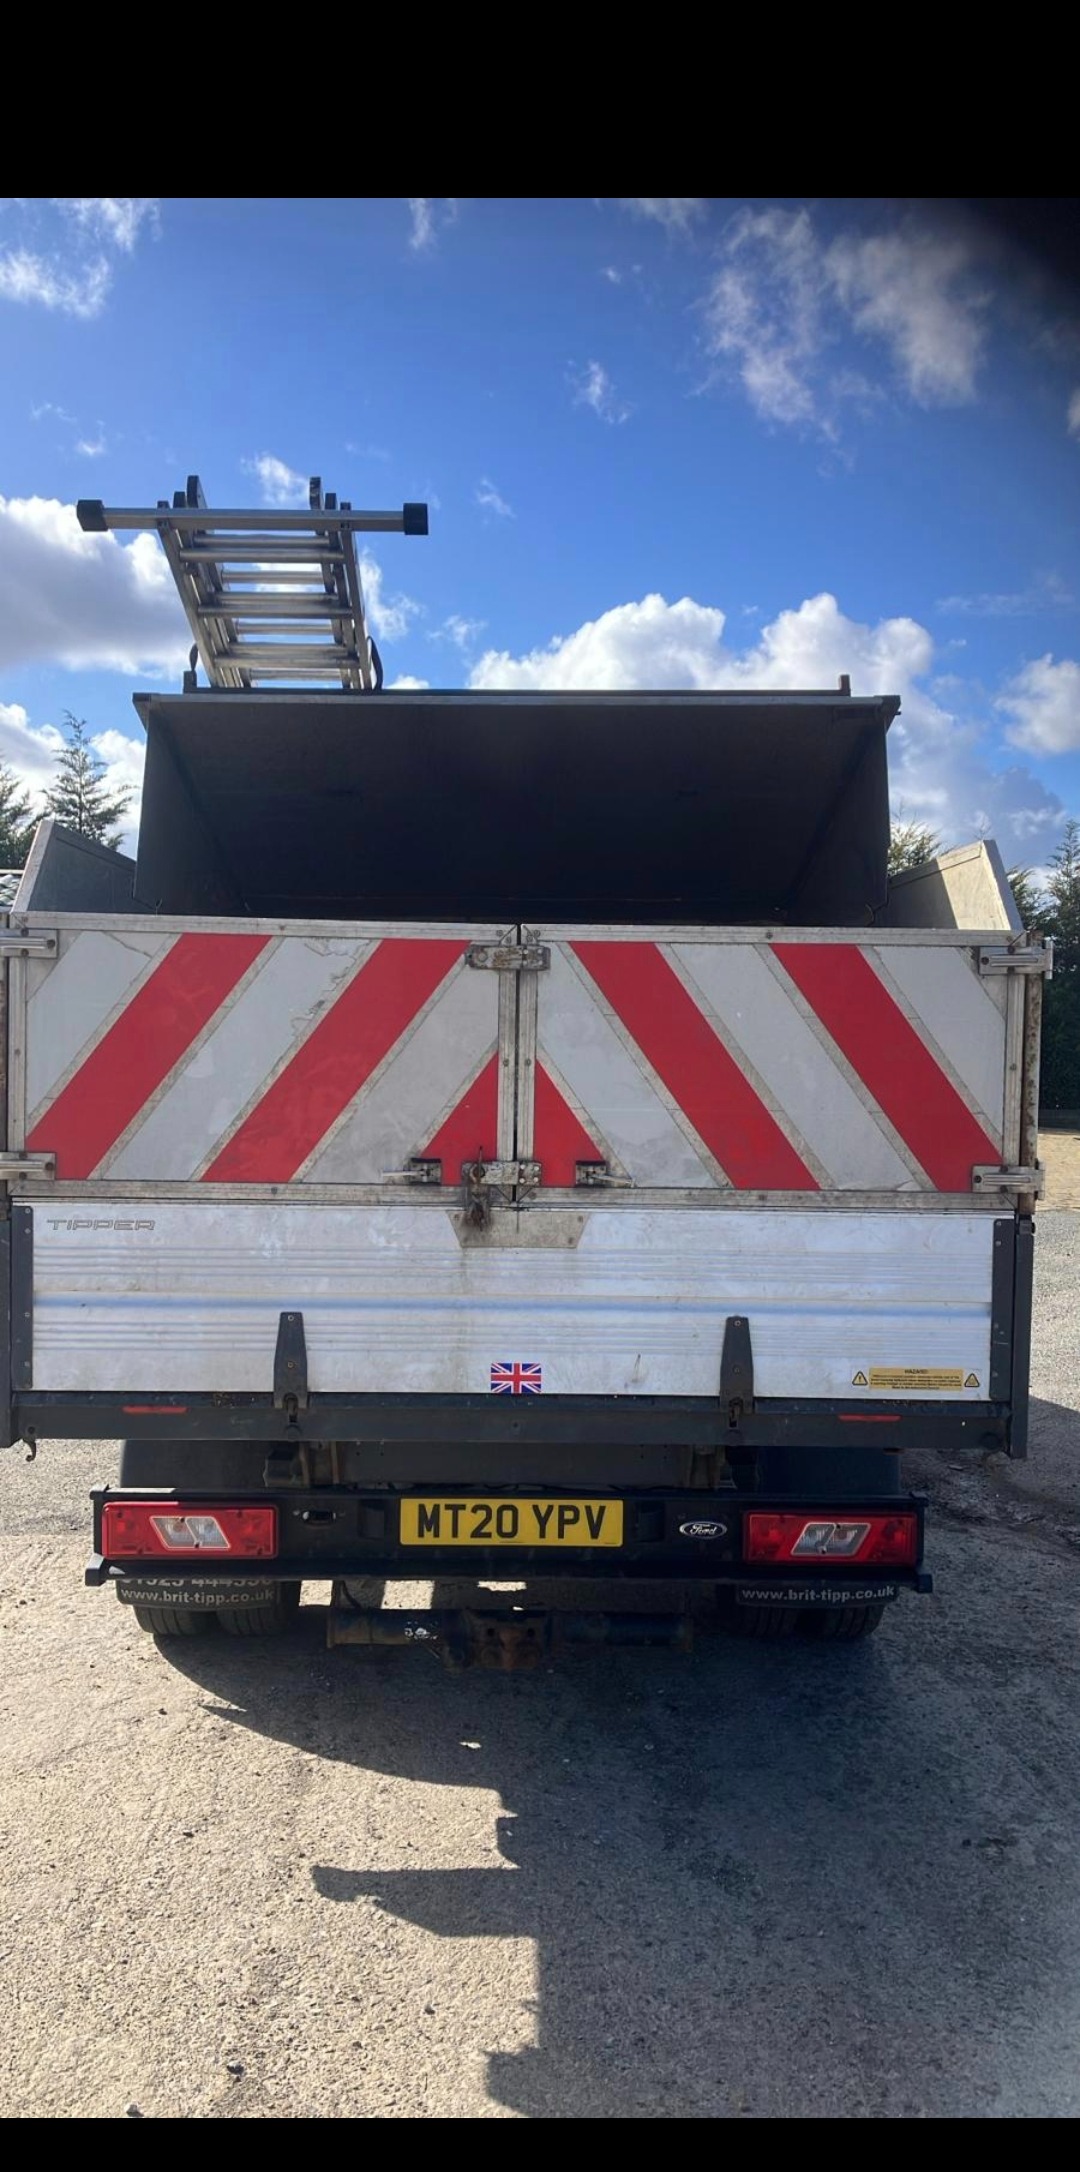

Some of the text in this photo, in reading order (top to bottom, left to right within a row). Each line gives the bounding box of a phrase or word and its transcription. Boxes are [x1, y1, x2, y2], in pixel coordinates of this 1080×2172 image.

[46, 1219, 155, 1230] TIPPER
[417, 1503, 606, 1540] MT20 YPV
[690, 1523, 717, 1535] Ford
[121, 1588, 275, 1605] www.brit-tipp.co.uk
[742, 1586, 894, 1603] www.brit-tipp.co.uk
